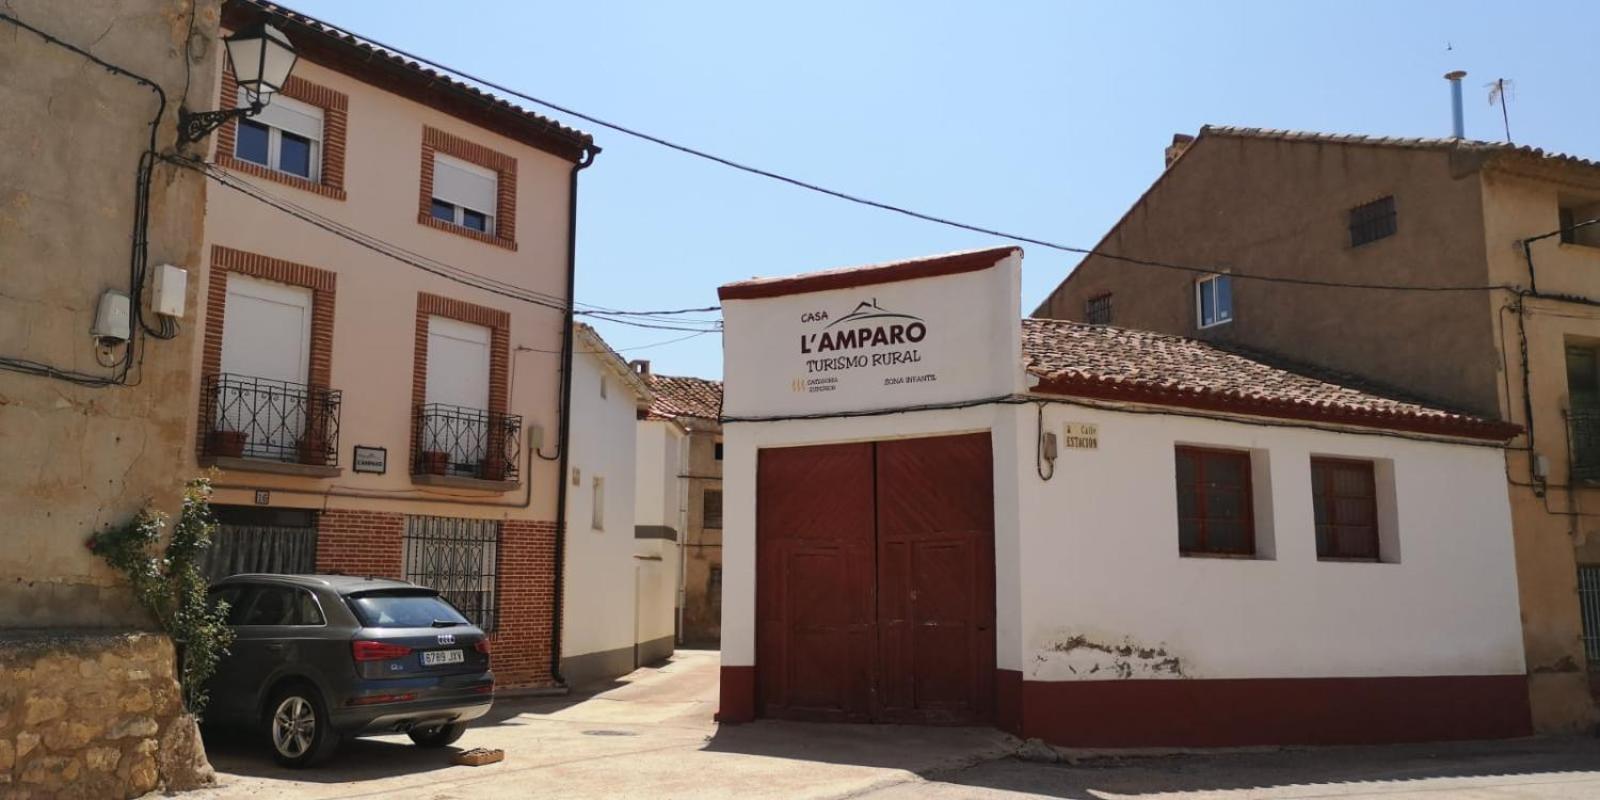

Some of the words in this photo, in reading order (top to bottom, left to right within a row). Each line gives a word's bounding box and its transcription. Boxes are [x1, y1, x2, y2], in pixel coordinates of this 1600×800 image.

[801, 311, 828, 323] CASA
[801, 322, 926, 354] L'AMPARO
[806, 355, 868, 373] TURISMO
[872, 350, 921, 367] RURAL
[884, 378, 904, 386] ZONA
[905, 374, 937, 384] INFANTIL
[1081, 424, 1097, 434] Calle
